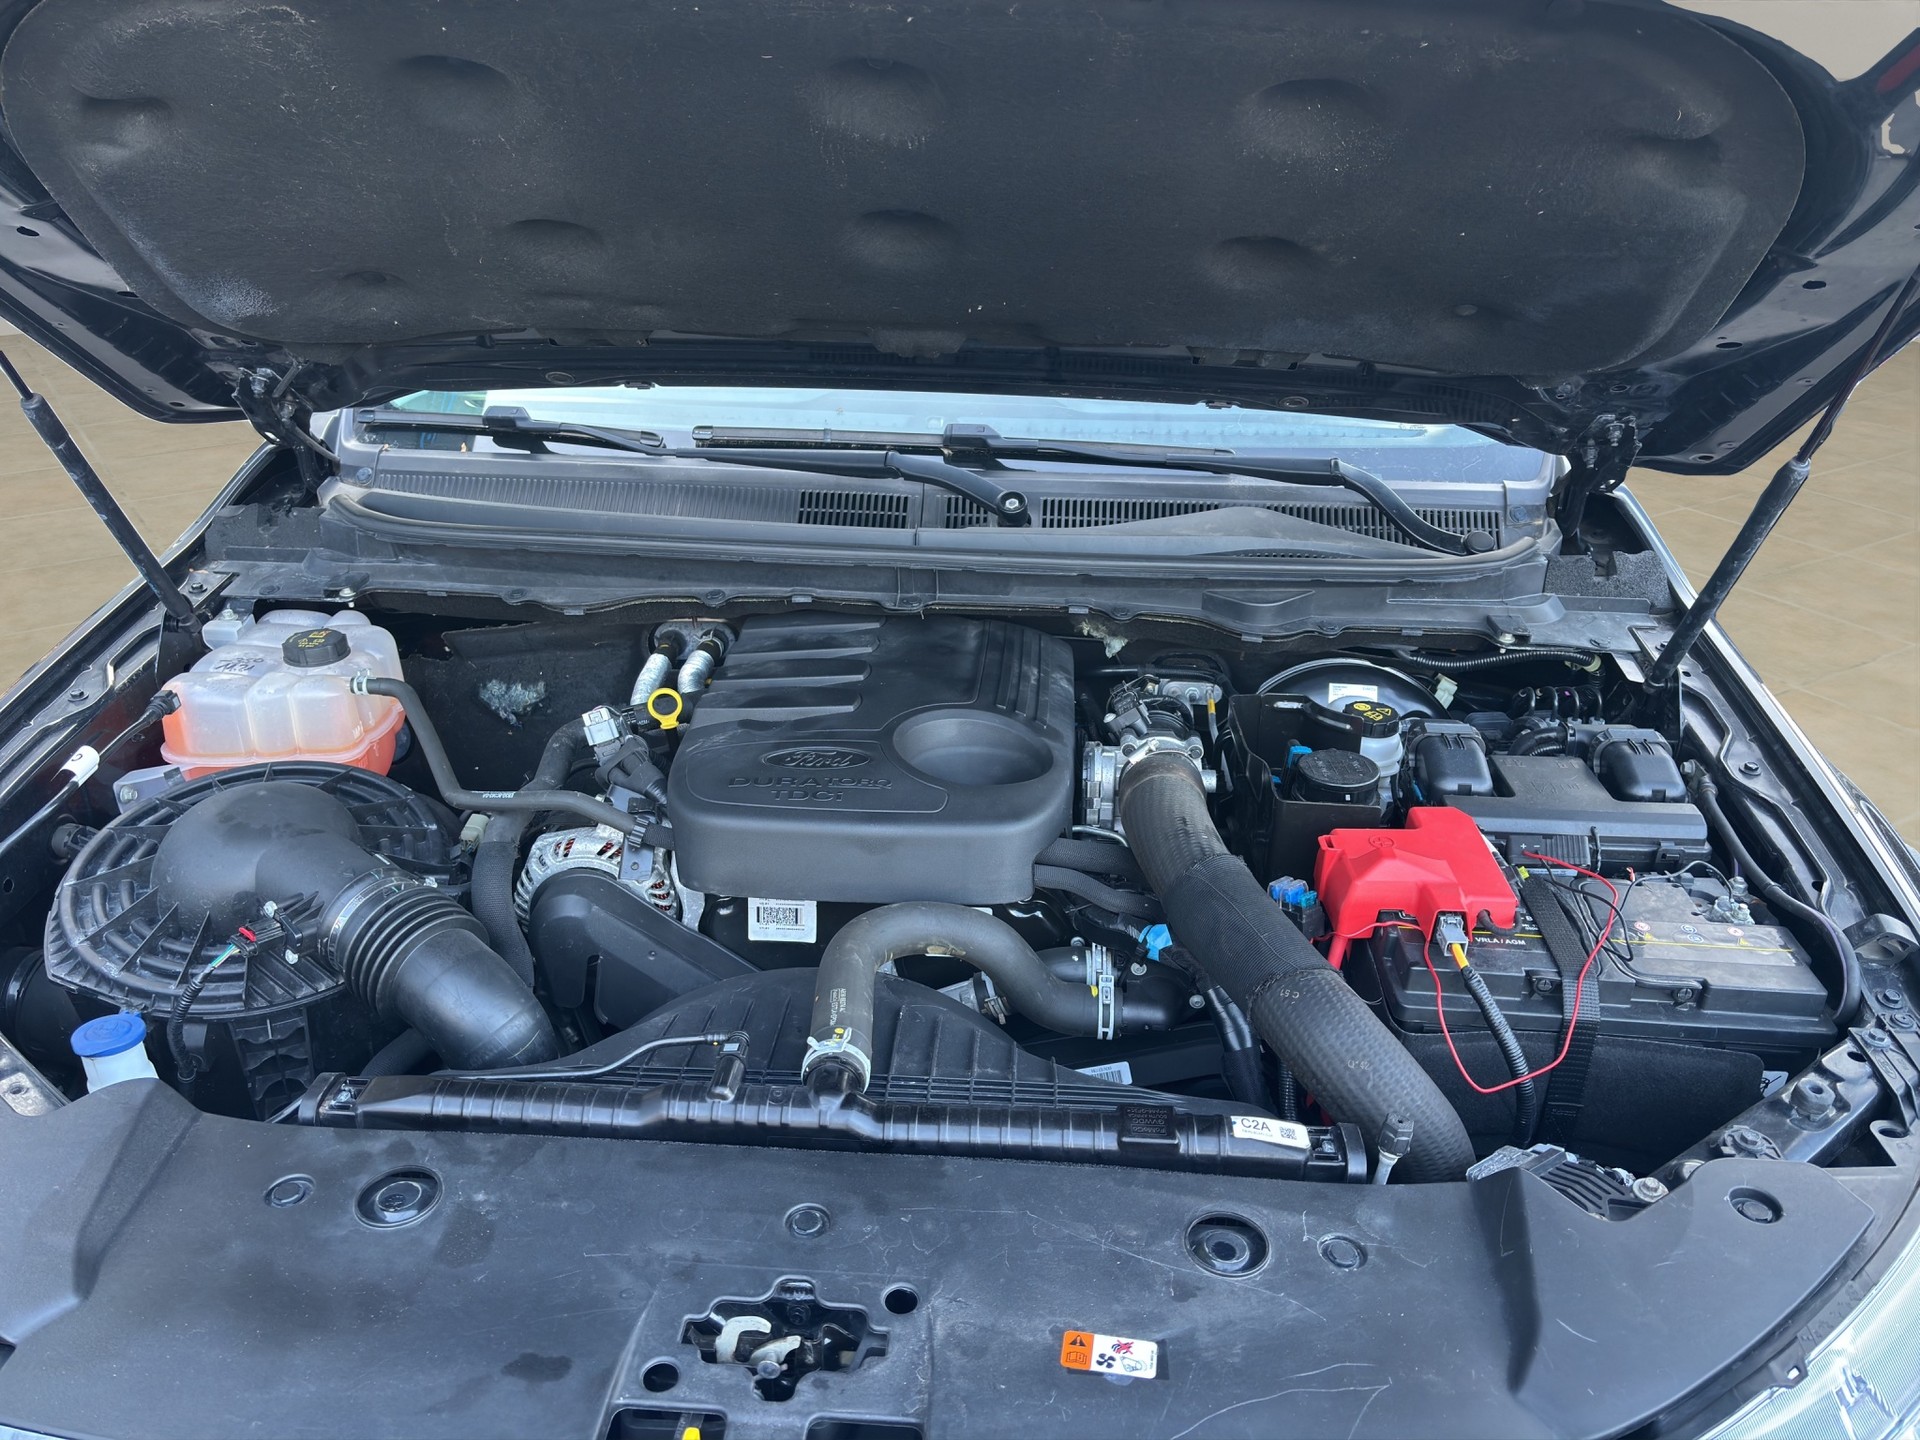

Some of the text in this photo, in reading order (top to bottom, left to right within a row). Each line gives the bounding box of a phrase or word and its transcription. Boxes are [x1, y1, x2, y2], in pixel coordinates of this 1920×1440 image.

[784, 750, 854, 767] Ford
[728, 776, 893, 790] DURATORQ
[1240, 1117, 1271, 1132] C2A
